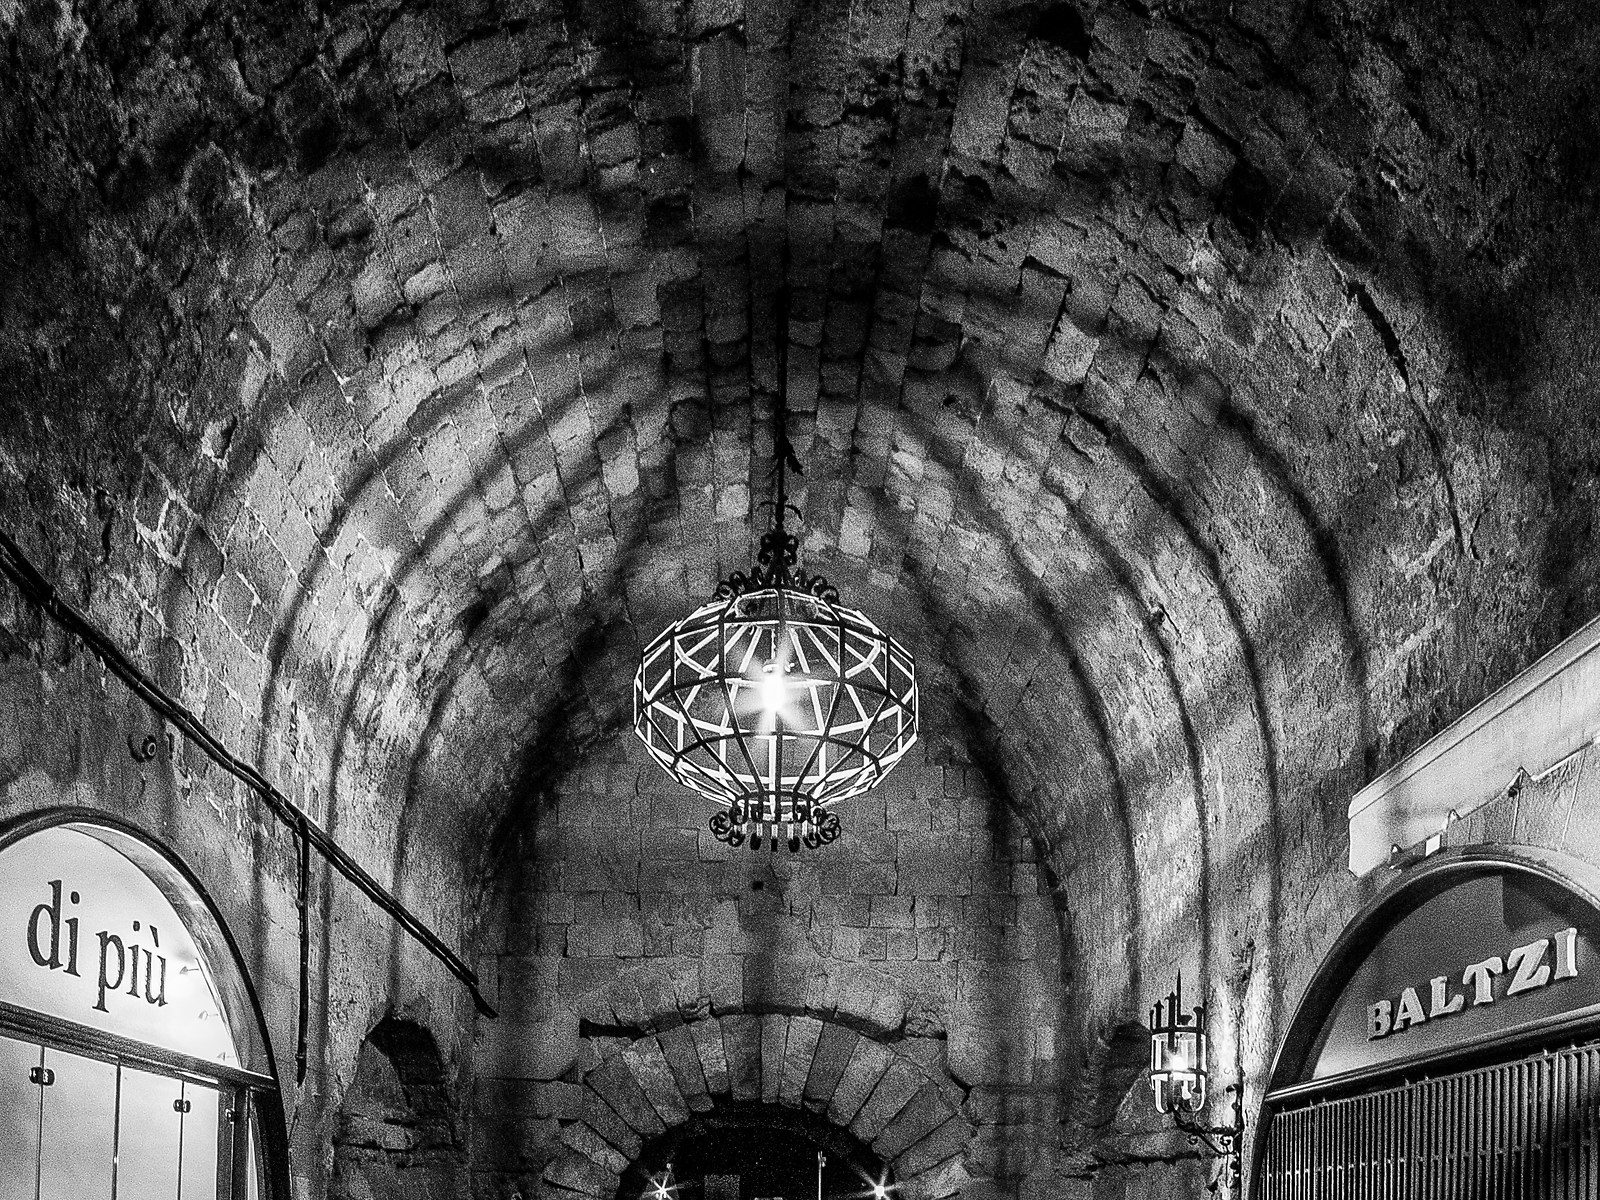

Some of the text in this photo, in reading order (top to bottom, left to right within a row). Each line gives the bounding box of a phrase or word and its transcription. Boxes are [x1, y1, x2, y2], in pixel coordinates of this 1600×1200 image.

[26, 879, 168, 1013] di più
[1366, 927, 1578, 1041] BALTZI
